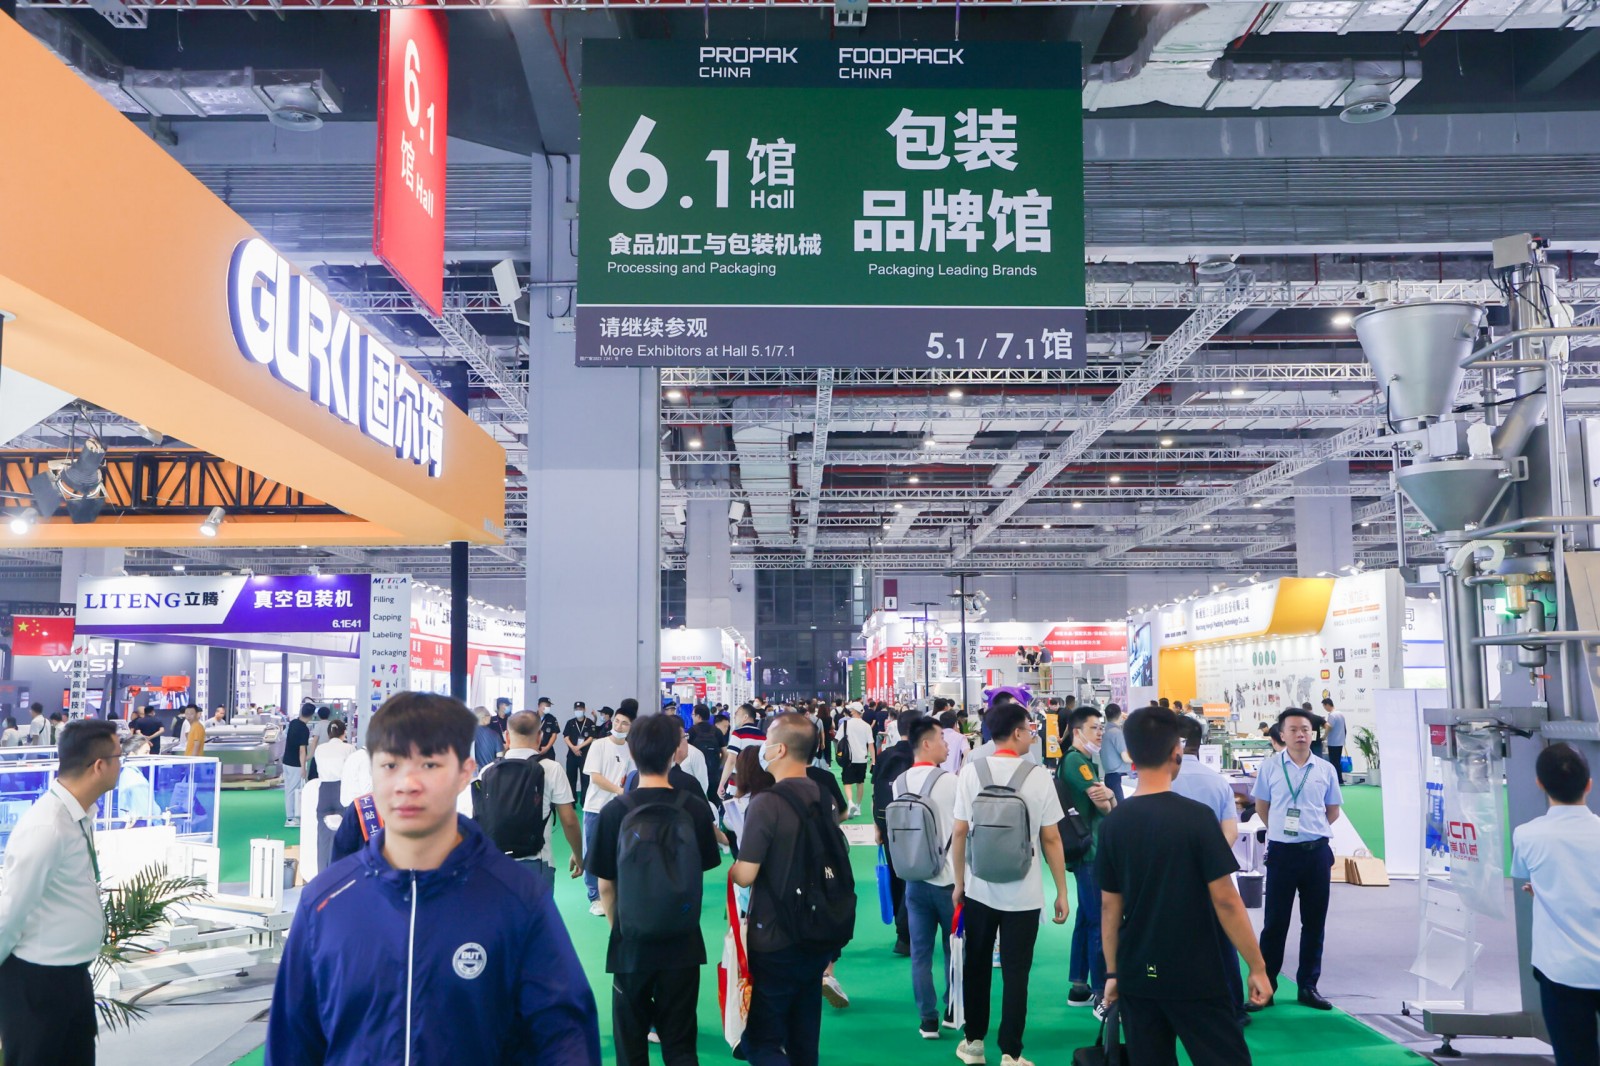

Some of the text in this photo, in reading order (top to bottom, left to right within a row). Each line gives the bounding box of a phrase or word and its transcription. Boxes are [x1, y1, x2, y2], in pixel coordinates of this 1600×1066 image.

[699, 47, 798, 64] PROPAK
[838, 47, 965, 65] FOODPACK
[699, 66, 751, 79] CHINA
[838, 67, 892, 79] CHINA
[404, 38, 436, 156] 6.1
[885, 107, 1019, 172] 包装
[608, 114, 796, 210] 6.1 馆
[400, 129, 434, 219] 馆 Hall
[750, 189, 795, 209] Hall
[853, 188, 1053, 253] 品牌馆
[608, 232, 822, 257] 食品加工与包装机械
[607, 260, 777, 277] Processing and Packaging
[868, 262, 1038, 278] Packaging Leading Brands
[227, 237, 361, 427] GURKI
[599, 316, 709, 339] 请继续参观
[599, 343, 796, 358] More Exhibitors at Hall 5.1/7.1
[925, 332, 966, 361] 5.1
[84, 591, 220, 611] LITENG 立腾
[253, 588, 354, 609] 真空包装机
[373, 596, 395, 605] Filling
[331, 619, 362, 629] 6.1E41
[372, 613, 402, 623] Capping
[372, 631, 403, 640] Labeling
[371, 649, 407, 657] Packaging
[968, 639, 977, 672] 恒力包装
[47, 658, 125, 673] WSP
[70, 660, 82, 719] 国家高新技术
